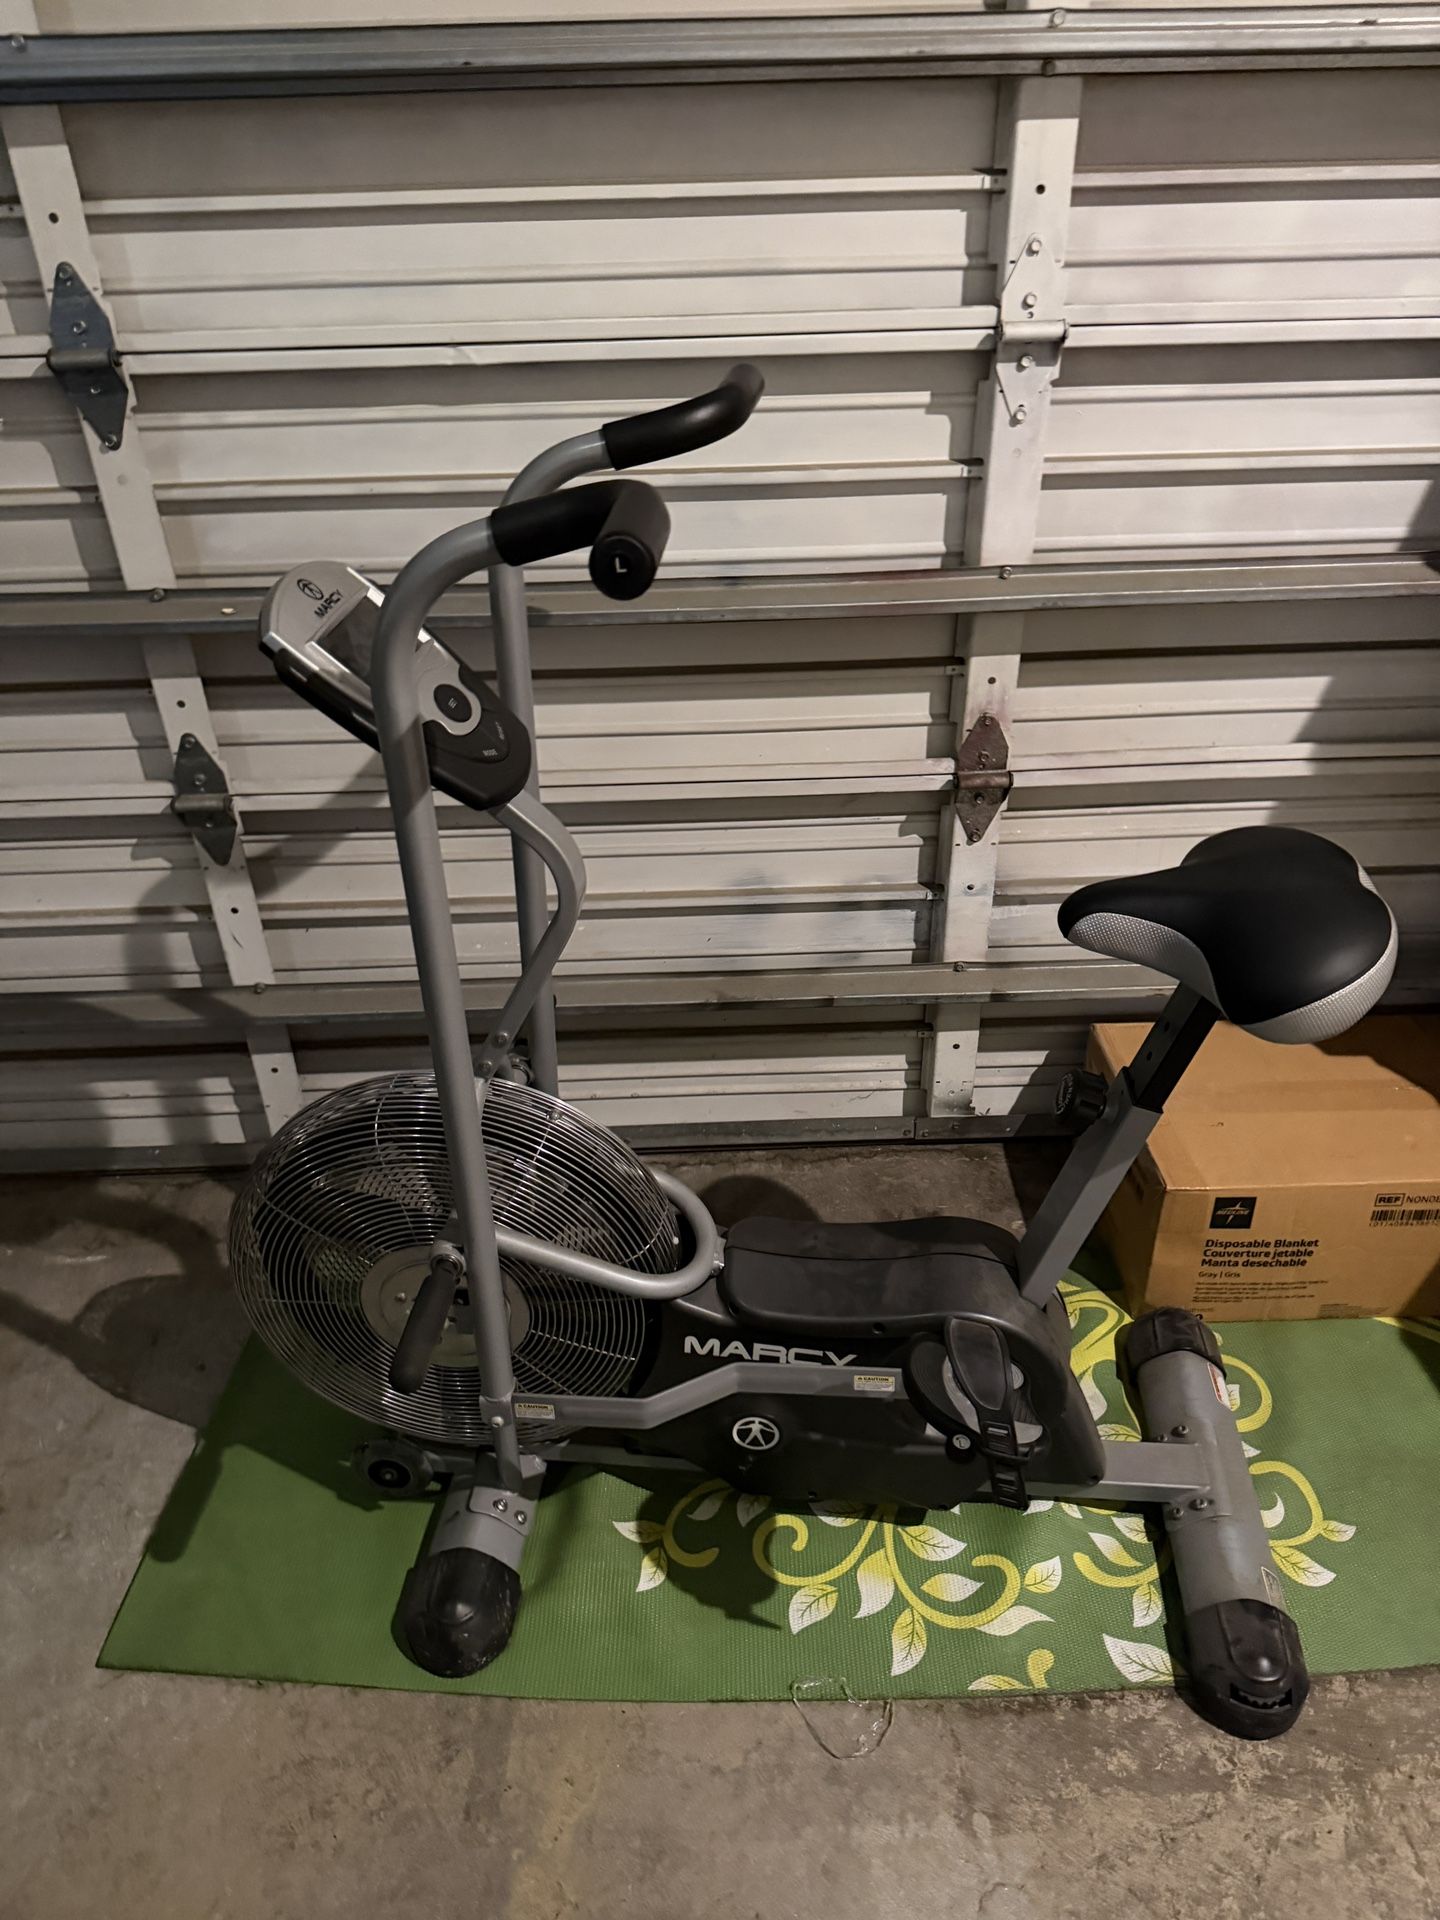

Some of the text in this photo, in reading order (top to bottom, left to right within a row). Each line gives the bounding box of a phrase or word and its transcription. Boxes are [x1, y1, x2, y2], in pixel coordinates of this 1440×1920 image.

[614, 557, 628, 573] L
[314, 589, 344, 617] MARCY
[1378, 1195, 1402, 1204] REF
[1205, 1239, 1320, 1249] Disposable Blanket
[1203, 1248, 1314, 1260] Couverture jetable
[1200, 1258, 1308, 1267] Manta desechable
[684, 1335, 858, 1366] MARCY
